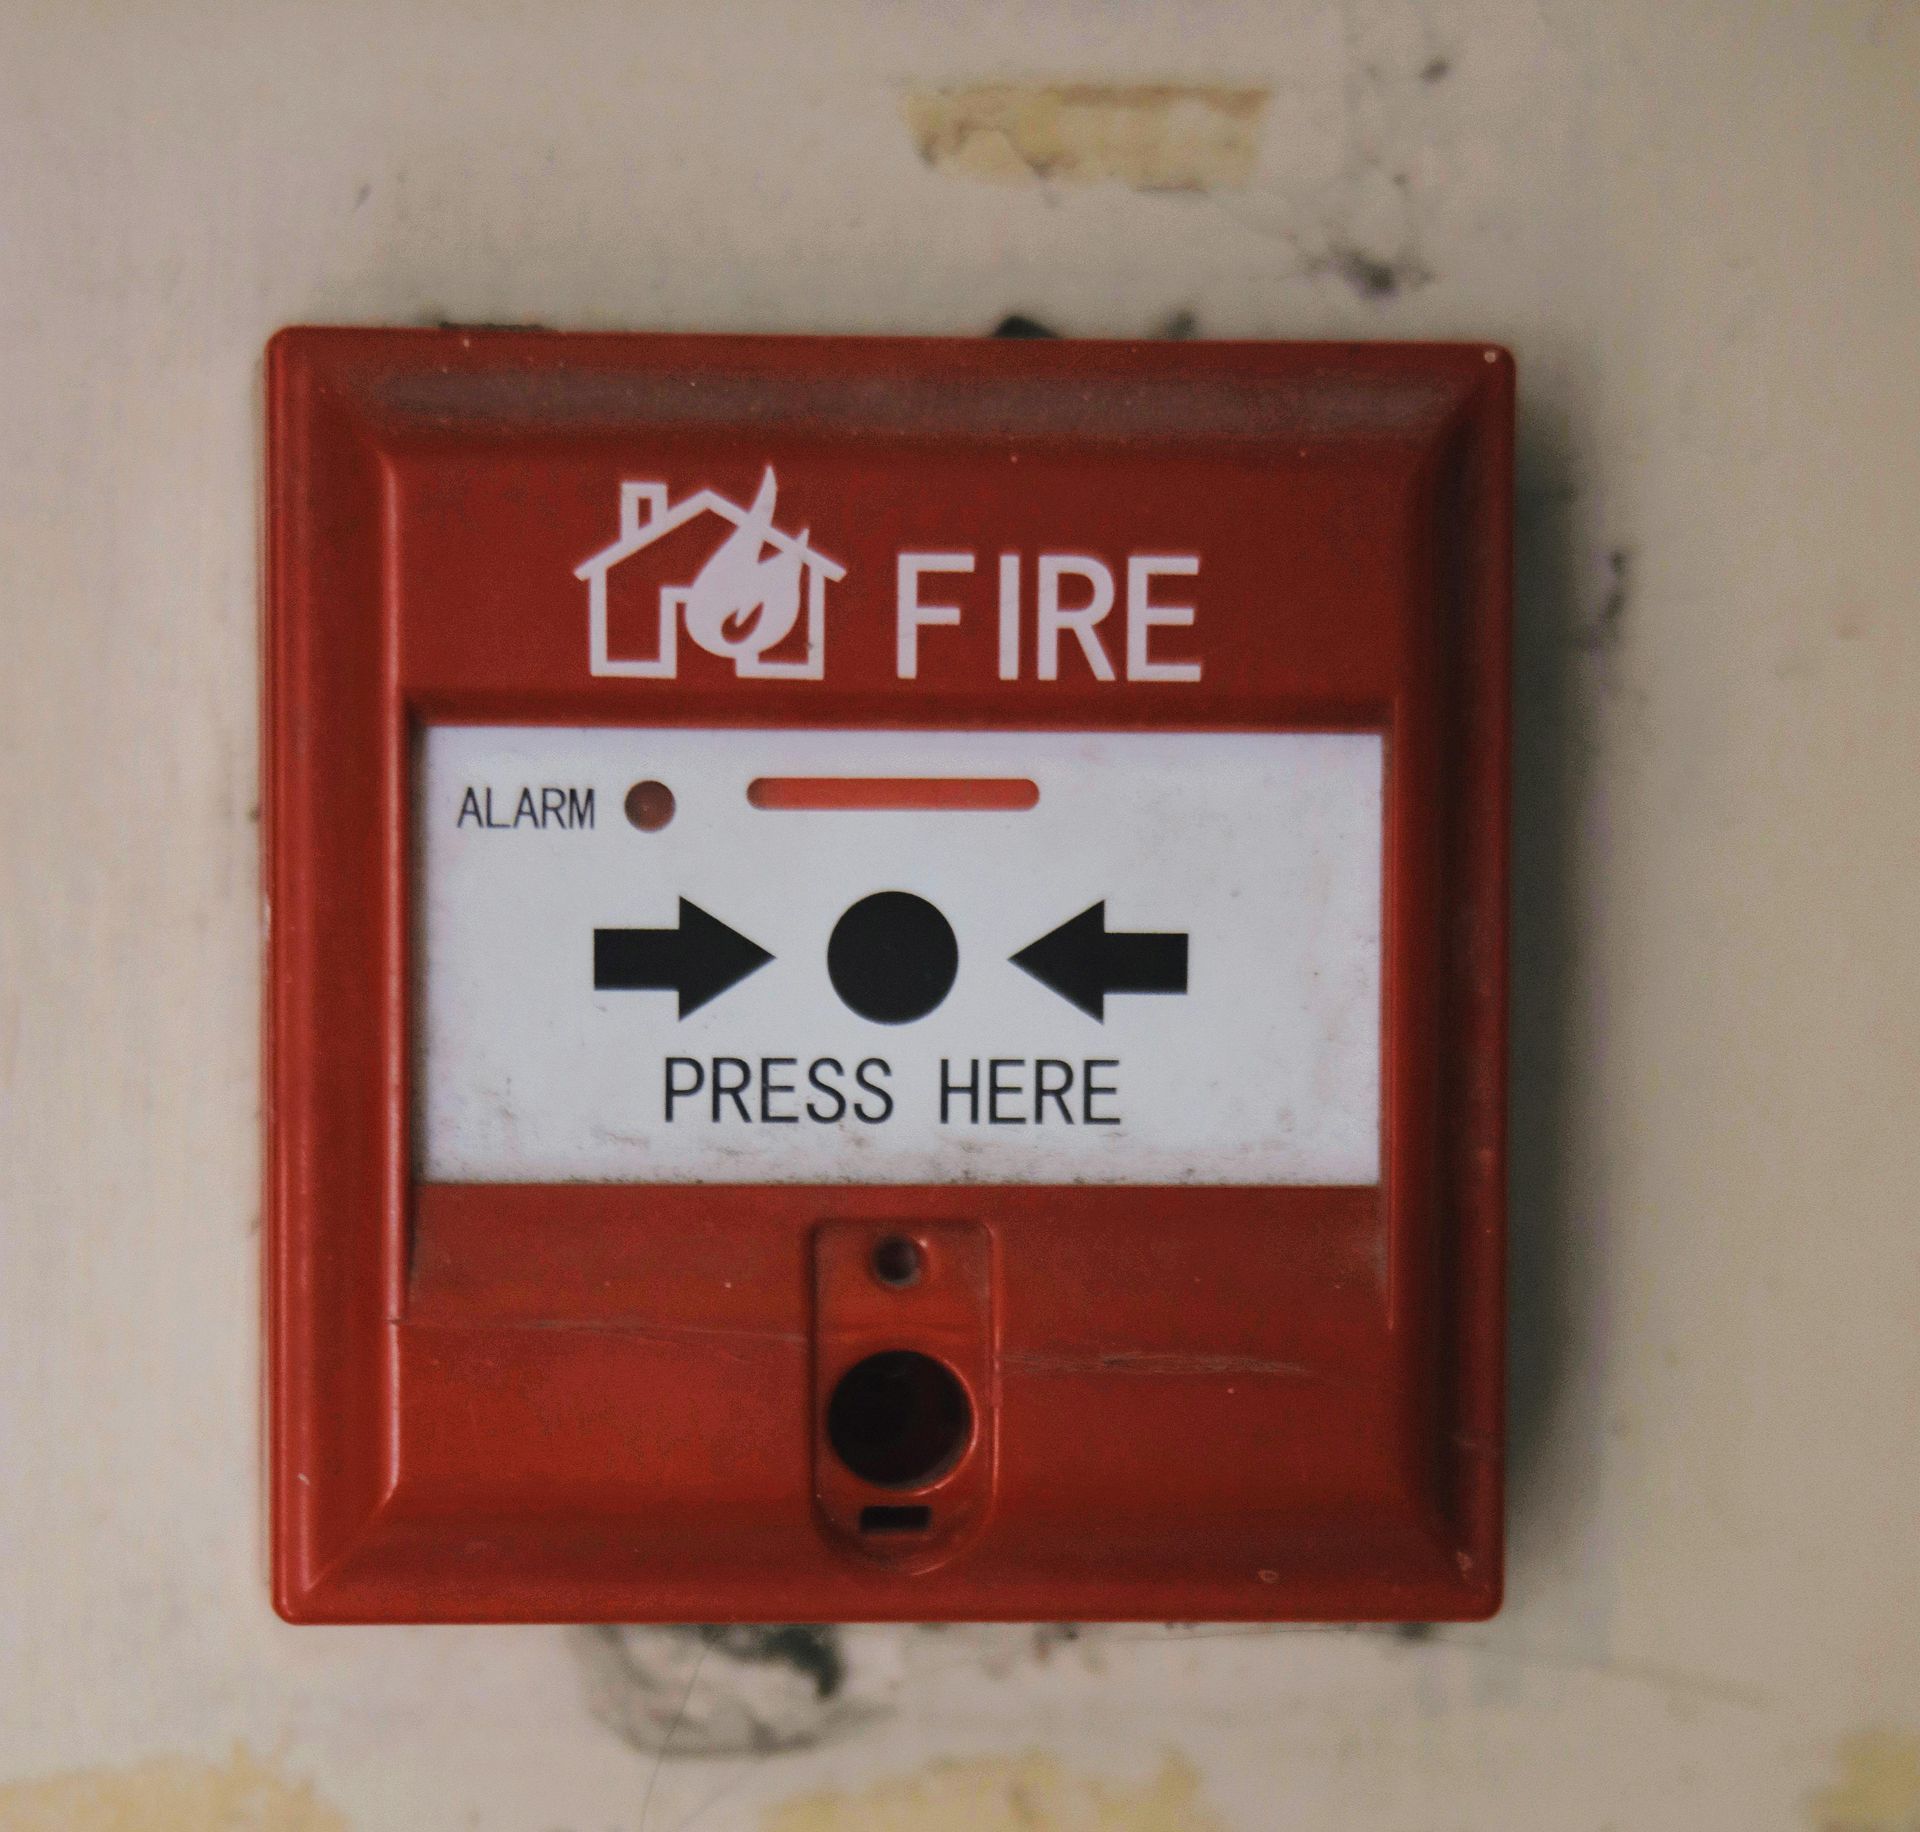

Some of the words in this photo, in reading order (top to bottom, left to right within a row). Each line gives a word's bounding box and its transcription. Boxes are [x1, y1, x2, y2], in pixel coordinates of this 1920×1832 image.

[896, 553, 1203, 682] FIRE
[456, 785, 596, 830] ALARM
[664, 1056, 895, 1125] PRESS
[939, 1058, 1122, 1126] HERE
